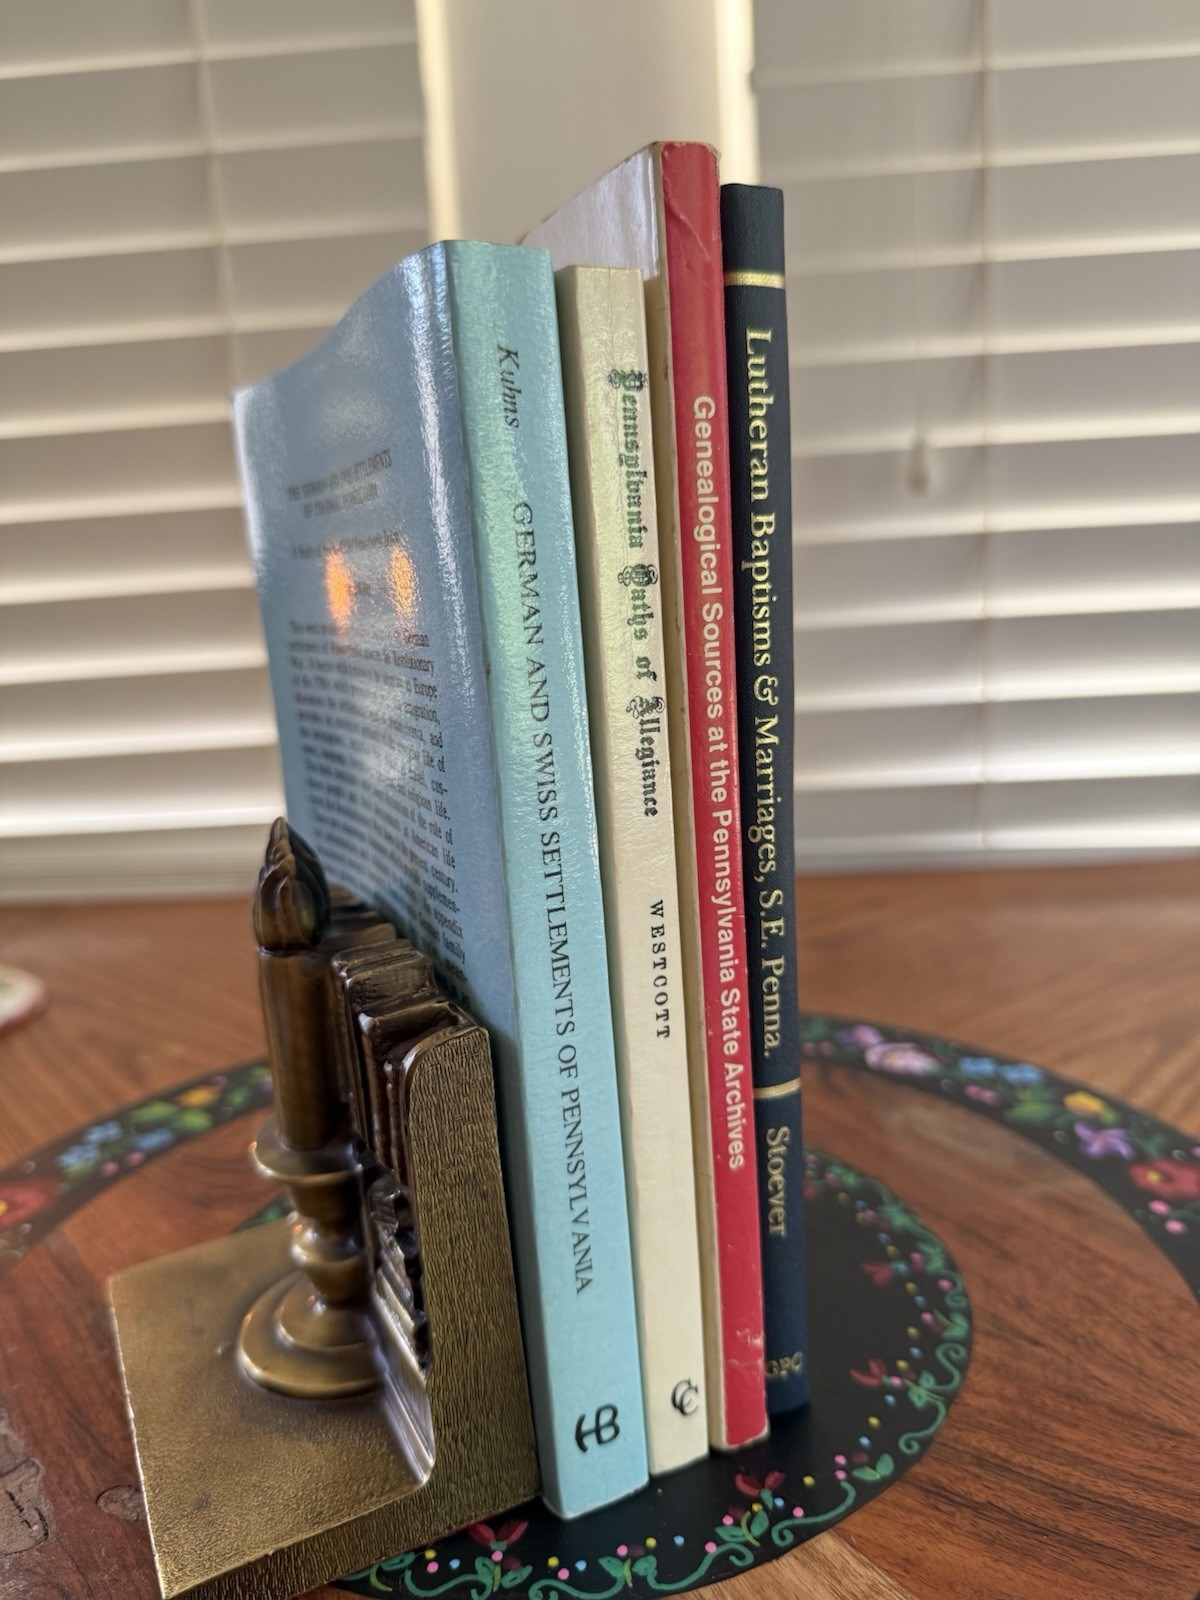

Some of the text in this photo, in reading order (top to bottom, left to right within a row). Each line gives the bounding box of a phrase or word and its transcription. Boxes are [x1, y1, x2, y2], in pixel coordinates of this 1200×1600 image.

[497, 344, 522, 428] Kuhns
[607, 368, 665, 817] Pennsylvania Oaths of Allegiance
[512, 502, 593, 1294] GERMAN AND SWISS SETTLEMENTS OF PENNSYLVANIA
[693, 396, 745, 1172] Genealogical Sources at the Pennsylvania State Archives
[741, 327, 786, 1058] Lutheran Baptisms & Marriages, S.E. Penna.
[650, 900, 671, 1039] WESTCOTT
[765, 1125, 791, 1238] Stoever
